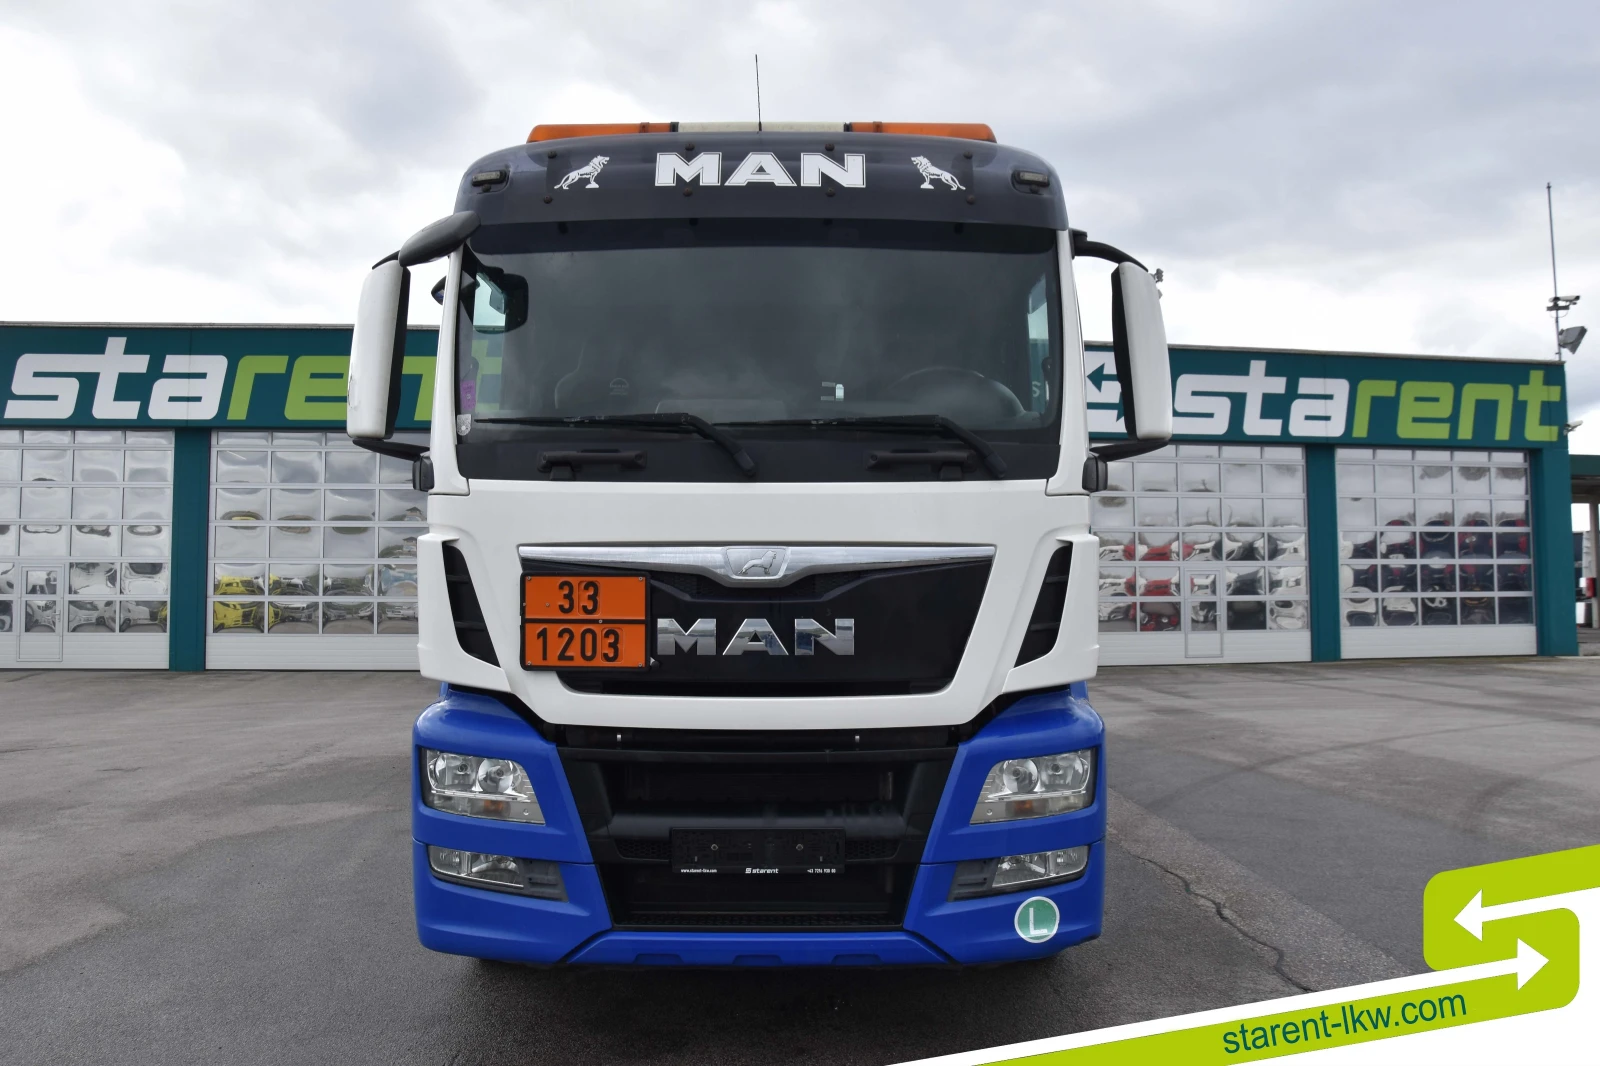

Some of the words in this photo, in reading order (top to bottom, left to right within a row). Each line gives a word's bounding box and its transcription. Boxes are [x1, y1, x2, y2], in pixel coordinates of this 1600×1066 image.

[655, 152, 867, 188] MAN
[1173, 360, 1561, 442] starent
[558, 580, 600, 615] 33
[536, 627, 620, 662] 1203
[657, 618, 855, 656] MAN
[1029, 907, 1048, 935] L
